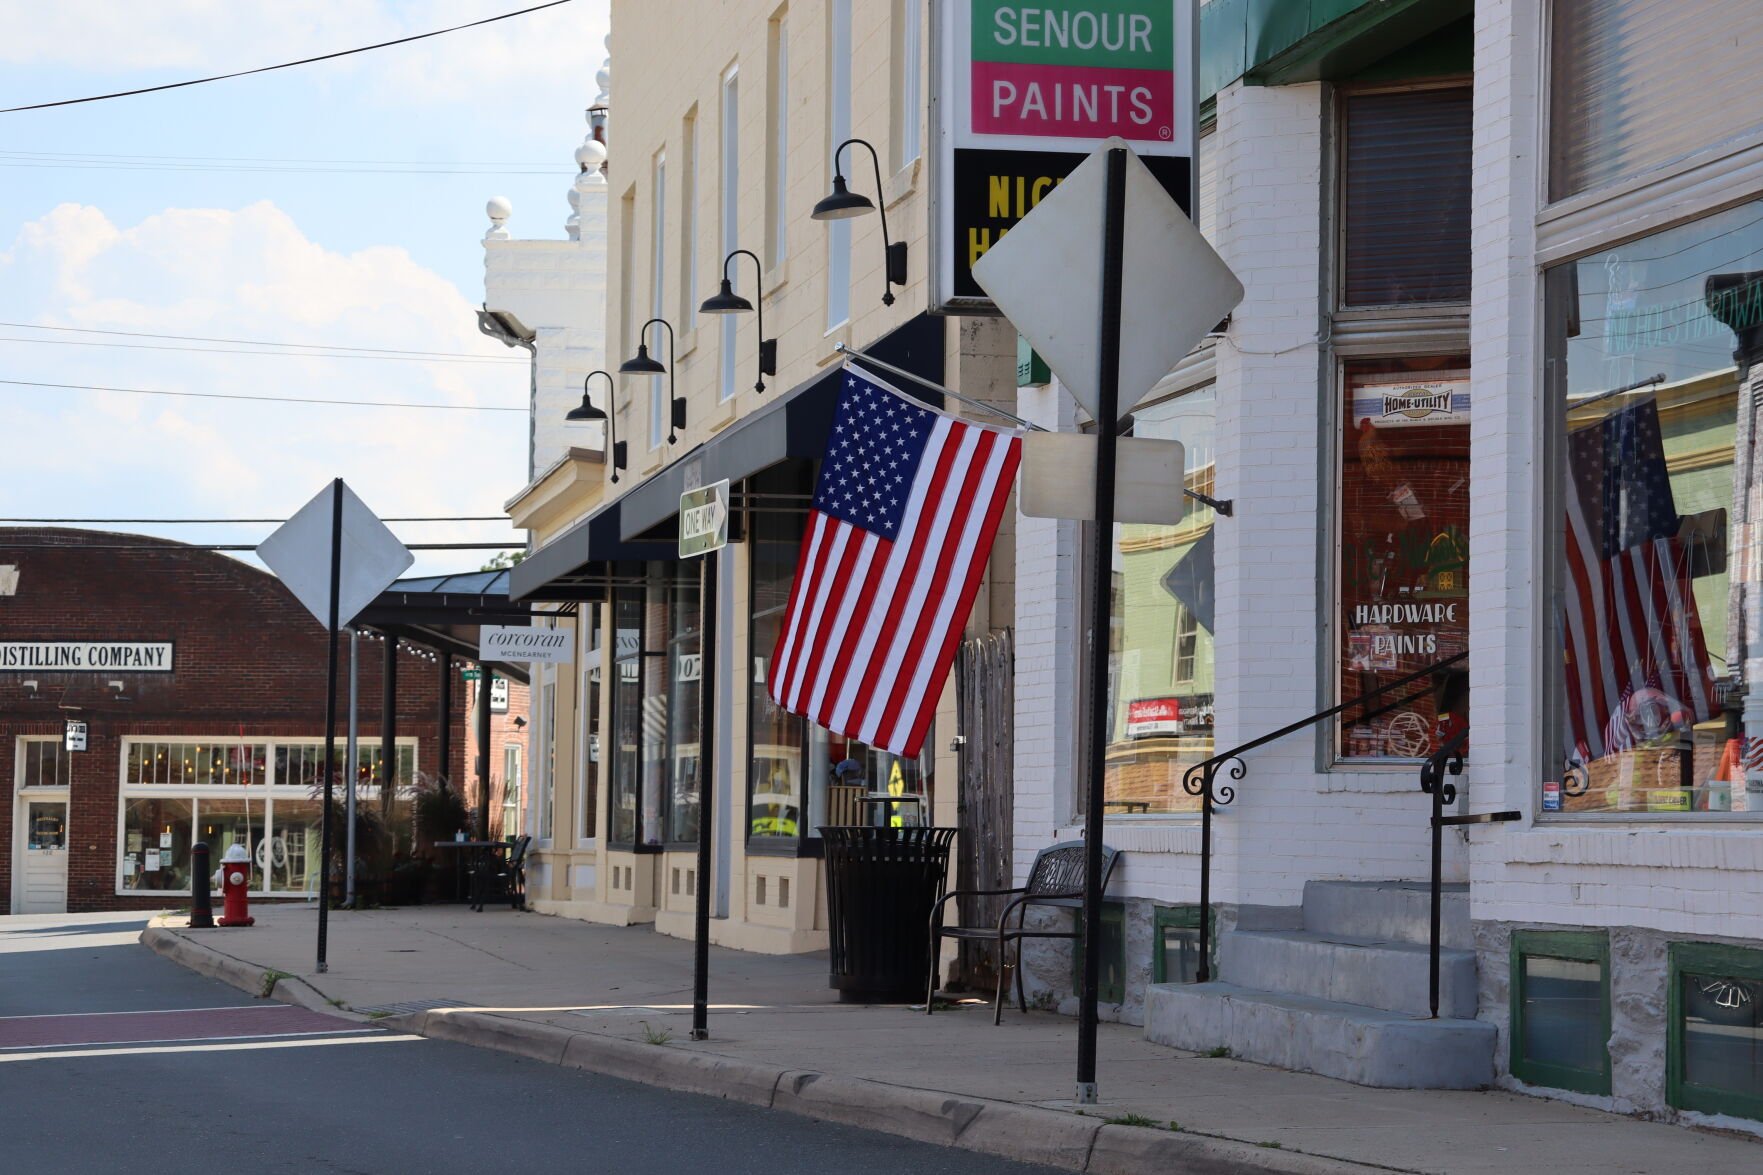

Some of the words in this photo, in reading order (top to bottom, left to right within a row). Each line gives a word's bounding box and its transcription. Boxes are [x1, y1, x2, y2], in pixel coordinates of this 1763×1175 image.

[993, 6, 1153, 53] SENOUR
[993, 79, 1153, 126] PAINTS
[989, 175, 1064, 218] NIC
[1607, 299, 1680, 354] NICHOLS
[1384, 391, 1450, 414] HOME-UTILITY
[685, 509, 700, 536] ONE
[702, 504, 716, 531] WAY
[1355, 602, 1458, 624] HARDWARE
[488, 631, 565, 648] corcoran
[1374, 633, 1437, 655] PAINTS
[0, 645, 82, 667] ISTILLING
[88, 645, 166, 667] COMPANY
[500, 650, 552, 659] MCENEARNEY
